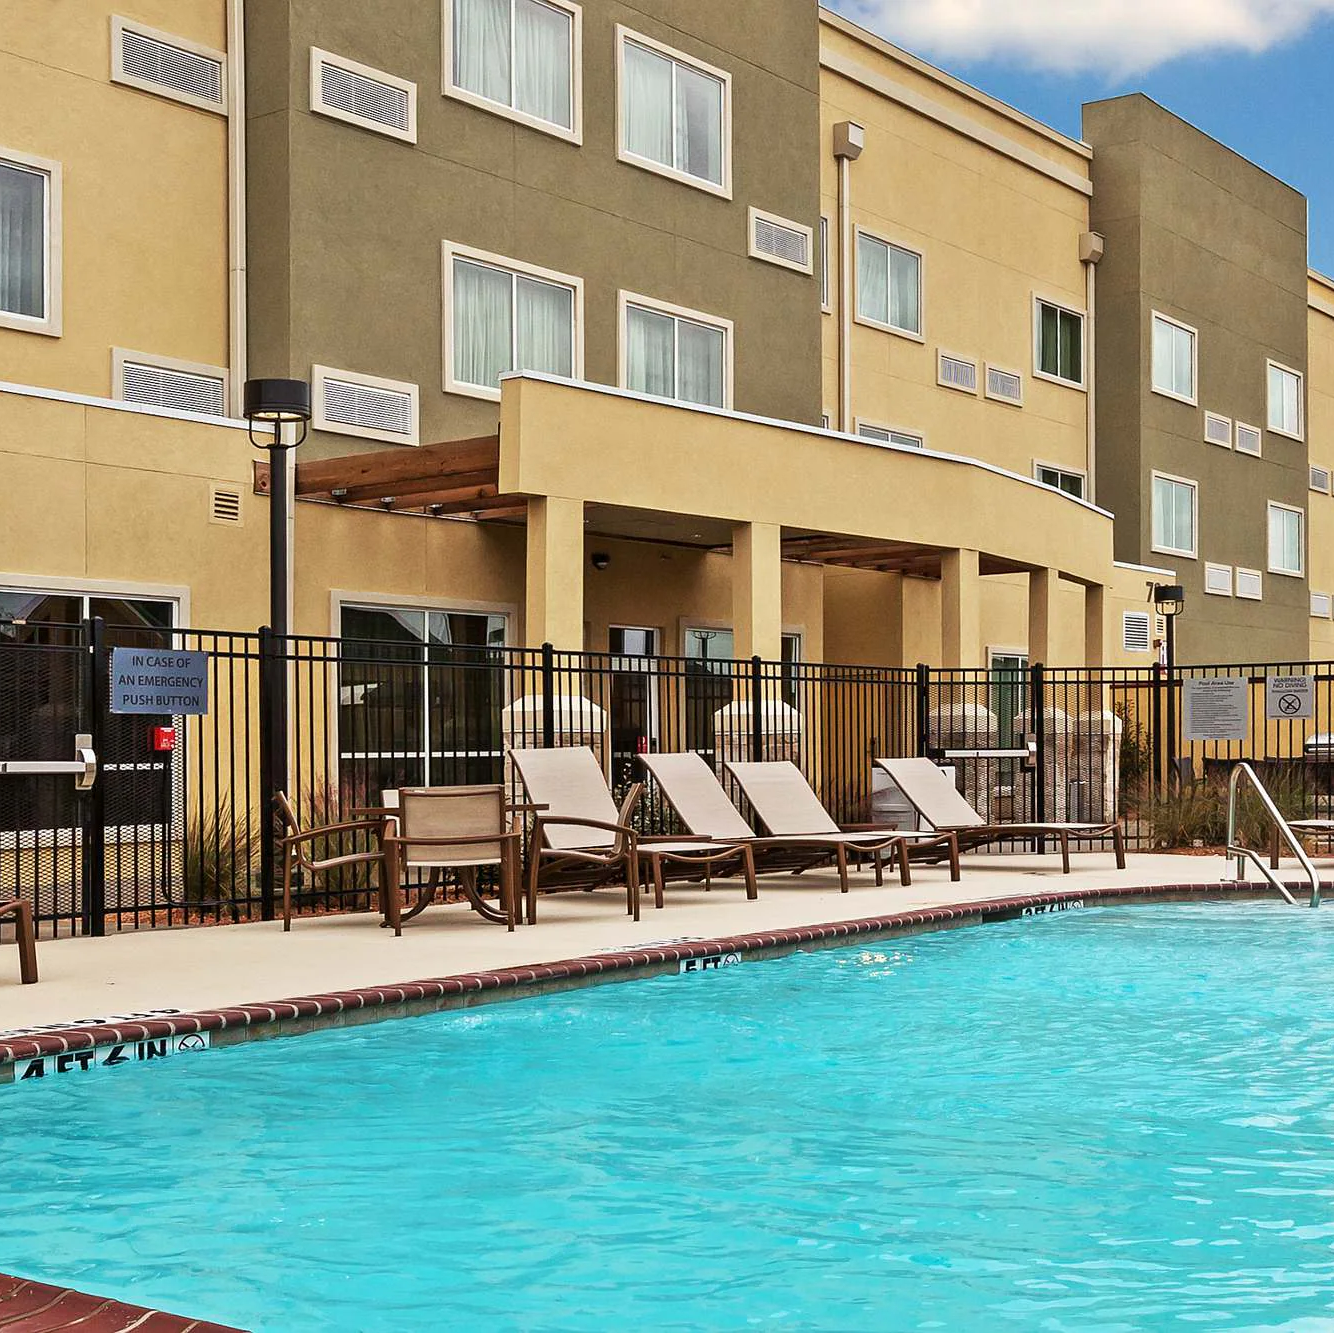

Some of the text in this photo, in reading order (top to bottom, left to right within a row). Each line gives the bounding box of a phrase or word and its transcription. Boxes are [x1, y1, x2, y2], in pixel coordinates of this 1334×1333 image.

[132, 655, 191, 668] IN CASE OF
[118, 674, 204, 688] AN EMERGENCY
[122, 694, 200, 707] PUSH BUTTON
[702, 956, 721, 971] FT
[20, 1058, 45, 1080] 4
[57, 1050, 94, 1073] FT
[138, 1039, 167, 1061] IN
